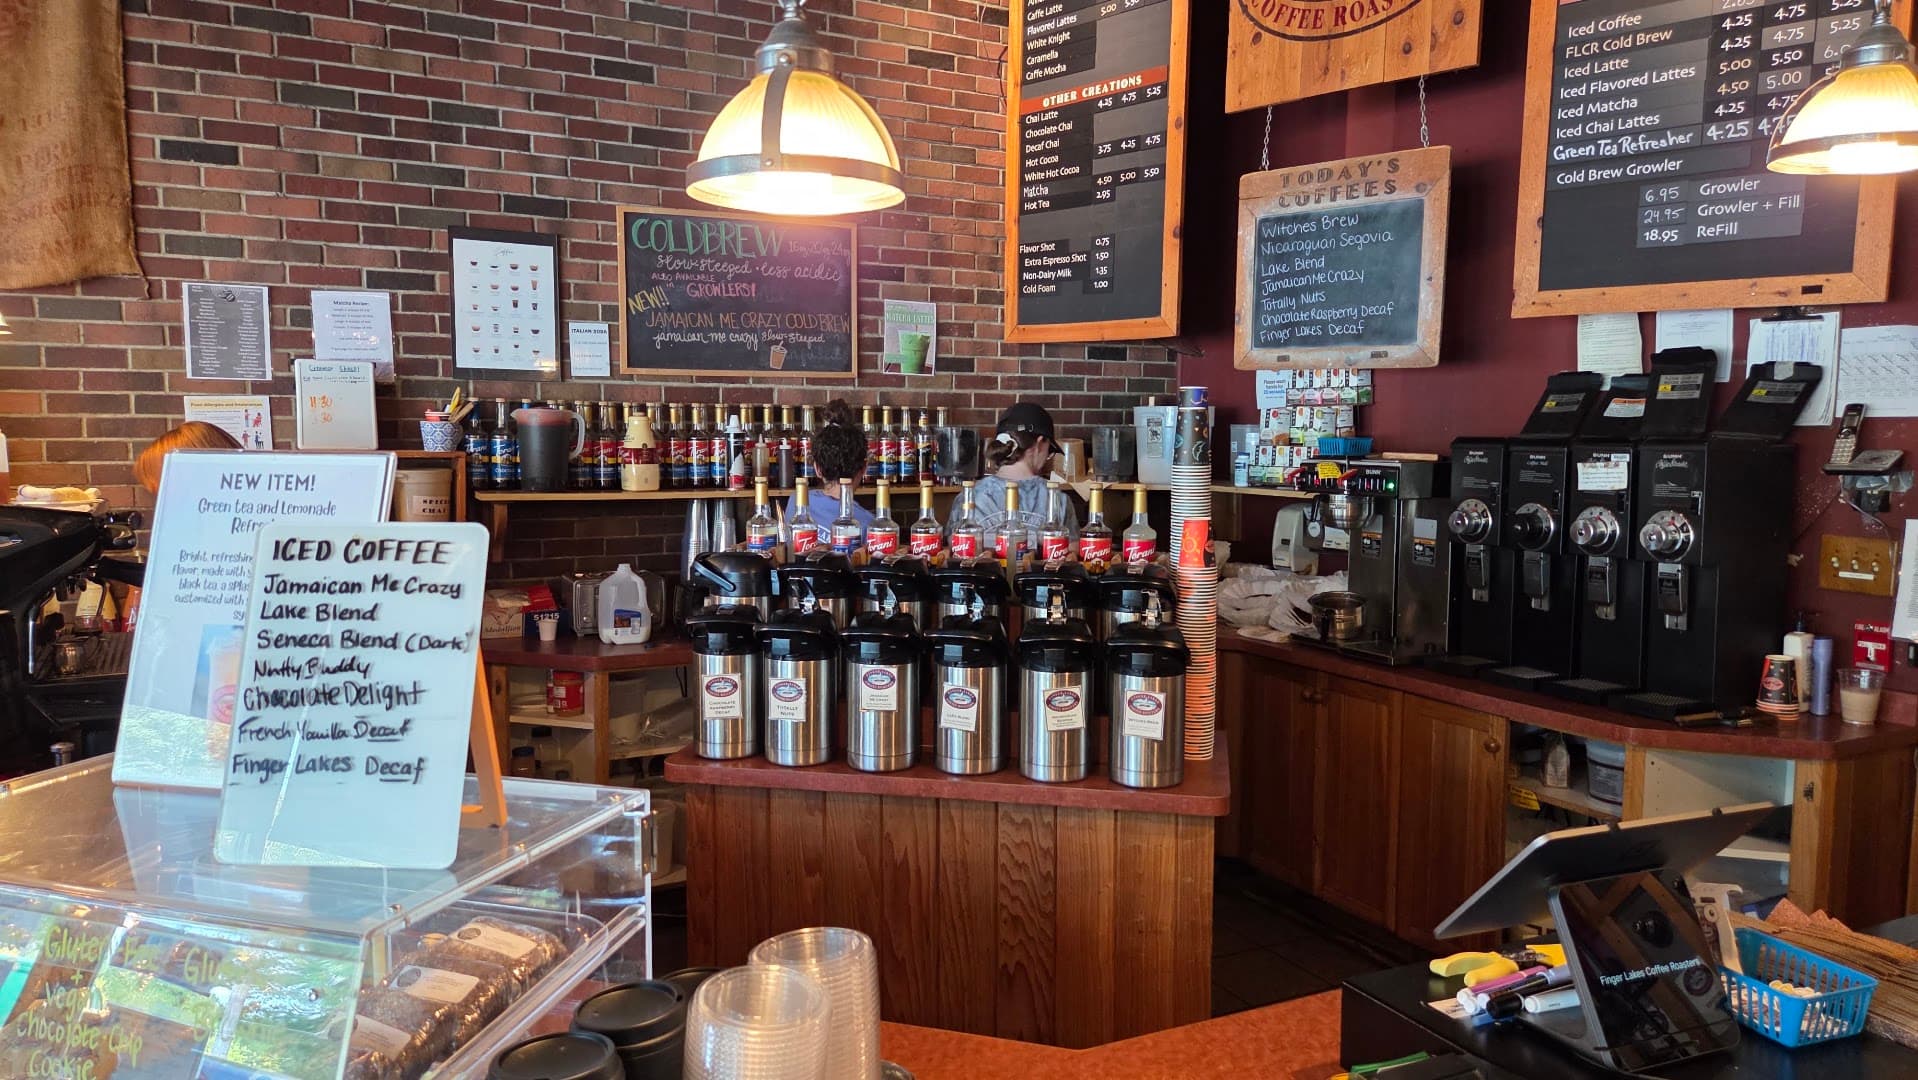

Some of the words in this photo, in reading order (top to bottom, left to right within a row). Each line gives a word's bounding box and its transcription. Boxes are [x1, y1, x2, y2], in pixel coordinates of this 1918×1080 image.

[1027, 6, 1044, 21] Caffe
[1045, 3, 1063, 16] Latte
[1027, 20, 1055, 36] Flavored
[1057, 14, 1078, 27] Lattes
[1101, 3, 1117, 16] 5.00
[1565, 43, 1599, 59] FLCR
[1602, 36, 1632, 52] Cold
[1636, 29, 1673, 45] Brew
[1722, 14, 1753, 30] 4.25
[1774, 4, 1806, 20] 4.75
[1568, 22, 1595, 39] Iced
[1598, 14, 1642, 32] Coffee
[1027, 37, 1047, 51] White
[1048, 30, 1071, 46] Knight
[1564, 62, 1590, 79] Iced
[1594, 57, 1629, 74] Latte
[1720, 36, 1752, 52] 4.25
[1773, 26, 1805, 43] 4.75
[1829, 17, 1861, 34] 5.25
[1026, 50, 1058, 66] Caramella
[1026, 68, 1043, 81] Caffe
[1044, 64, 1066, 76] Mocha
[1560, 83, 1586, 99] Iced
[1590, 72, 1648, 93] Flavored
[1652, 66, 1696, 84] Lattes
[1719, 58, 1751, 75] 5.00
[1771, 50, 1803, 66] 5.50
[1043, 91, 1077, 107] OTHER
[1082, 75, 1142, 98] CREATIONS
[1557, 103, 1583, 120] Iced
[1586, 97, 1638, 115] Matcha
[1717, 80, 1749, 96] 4.50
[1767, 71, 1802, 89] 5.00
[1026, 113, 1040, 124] Chai
[1041, 110, 1058, 121] Latte
[1098, 97, 1112, 109] 4.25
[1121, 92, 1136, 104] 4.75
[1146, 86, 1161, 98] 5.25
[1026, 126, 1057, 139] Chocolate
[1058, 121, 1072, 132] Chai
[1556, 123, 1582, 139] Iced
[1586, 118, 1614, 135] Chai
[1618, 113, 1660, 130] Lattes
[1714, 101, 1745, 116] 4.25
[1026, 142, 1044, 154] Decaf
[1045, 138, 1060, 150] Chai
[1026, 157, 1038, 168] Hot
[1040, 154, 1059, 165] Cocoa
[1121, 139, 1136, 150] 4.25
[1146, 134, 1161, 146] 4.75
[1553, 145, 1595, 161] Green
[1597, 139, 1618, 156] Tea
[1618, 130, 1694, 154] Refresher
[1706, 121, 1749, 141] 4.25
[1024, 186, 1049, 198] Matcha
[1097, 176, 1112, 186] 4.50
[1120, 171, 1136, 182] 5.00
[1144, 167, 1160, 178] 5.50
[1025, 170, 1045, 182] White
[1046, 168, 1058, 178] Hot
[1060, 165, 1080, 176] Cocoa
[1280, 158, 1401, 189] TODAY'S
[1556, 169, 1584, 185] Cold
[1588, 166, 1623, 182] Brew
[1626, 158, 1683, 176] Growler
[1278, 179, 1397, 208] COFFEES
[1645, 186, 1681, 203] 6.95
[1699, 178, 1760, 196] Growler
[1024, 201, 1037, 211] Hot
[1038, 199, 1050, 209] Tea
[1643, 207, 1686, 224] 24.95
[1697, 199, 1758, 217] Growler
[1778, 194, 1800, 209] Fill
[1262, 220, 1317, 239] Witches
[1322, 213, 1359, 230] Brew
[1643, 229, 1679, 242] 18.95
[1696, 221, 1738, 238] ReFill
[1020, 244, 1040, 254] Flavor
[1041, 242, 1056, 252] Shot
[1261, 237, 1336, 256] Nicaraguan
[1339, 231, 1393, 250] Segovia
[1025, 257, 1041, 267] Extra
[1043, 254, 1070, 266] Espresso
[1071, 252, 1087, 263] Shot
[1261, 261, 1290, 277] Lake
[1295, 255, 1325, 272] Blend
[794, 263, 841, 282] acidic
[1023, 270, 1056, 281] Non-Dairy
[1057, 268, 1072, 278] Milk
[1262, 276, 1312, 296] Jamaican
[1327, 269, 1365, 284] Crazy
[1023, 285, 1036, 294] Cold
[1038, 284, 1056, 293] Foam
[1260, 295, 1296, 311] Totally
[1301, 290, 1326, 303] Nuts
[646, 312, 714, 329] JAMAICAN
[719, 312, 739, 329] ME
[741, 312, 783, 329] CRAZY
[1261, 311, 1310, 327] Chocolate
[1310, 305, 1358, 321] Raspberry
[1361, 301, 1395, 317] Decaf
[571, 327, 592, 335] ITALIAN
[1260, 327, 1293, 343] Finger
[1295, 323, 1322, 336] Lakes
[1328, 319, 1365, 336] Decaf
[220, 473, 262, 491] NEW
[267, 474, 316, 492] ITEM!
[198, 497, 232, 514] Green
[235, 499, 253, 514] tea
[256, 500, 278, 515] and
[281, 500, 337, 516] Lemonade
[273, 537, 332, 562] ICED
[343, 537, 455, 565] COFFEE
[911, 539, 939, 553] Torani
[263, 573, 362, 596] Jamaican
[371, 573, 400, 593] Me
[403, 576, 463, 600] Crazy
[260, 600, 309, 620] Lake
[315, 602, 379, 622] Blend
[257, 629, 331, 650] Seneca
[340, 630, 399, 650] Blend
[253, 657, 303, 682] Nutty
[243, 685, 340, 712] Chocolate
[343, 680, 428, 711] Delight
[238, 716, 292, 744] French
[232, 754, 291, 784] Finger
[295, 754, 352, 775] Lakes
[365, 756, 427, 785] Decaf
[1599, 974, 1623, 987] Finger
[1624, 969, 1645, 981] Lakes
[1645, 963, 1669, 976] Coffee
[1669, 957, 1702, 971] Roasters
